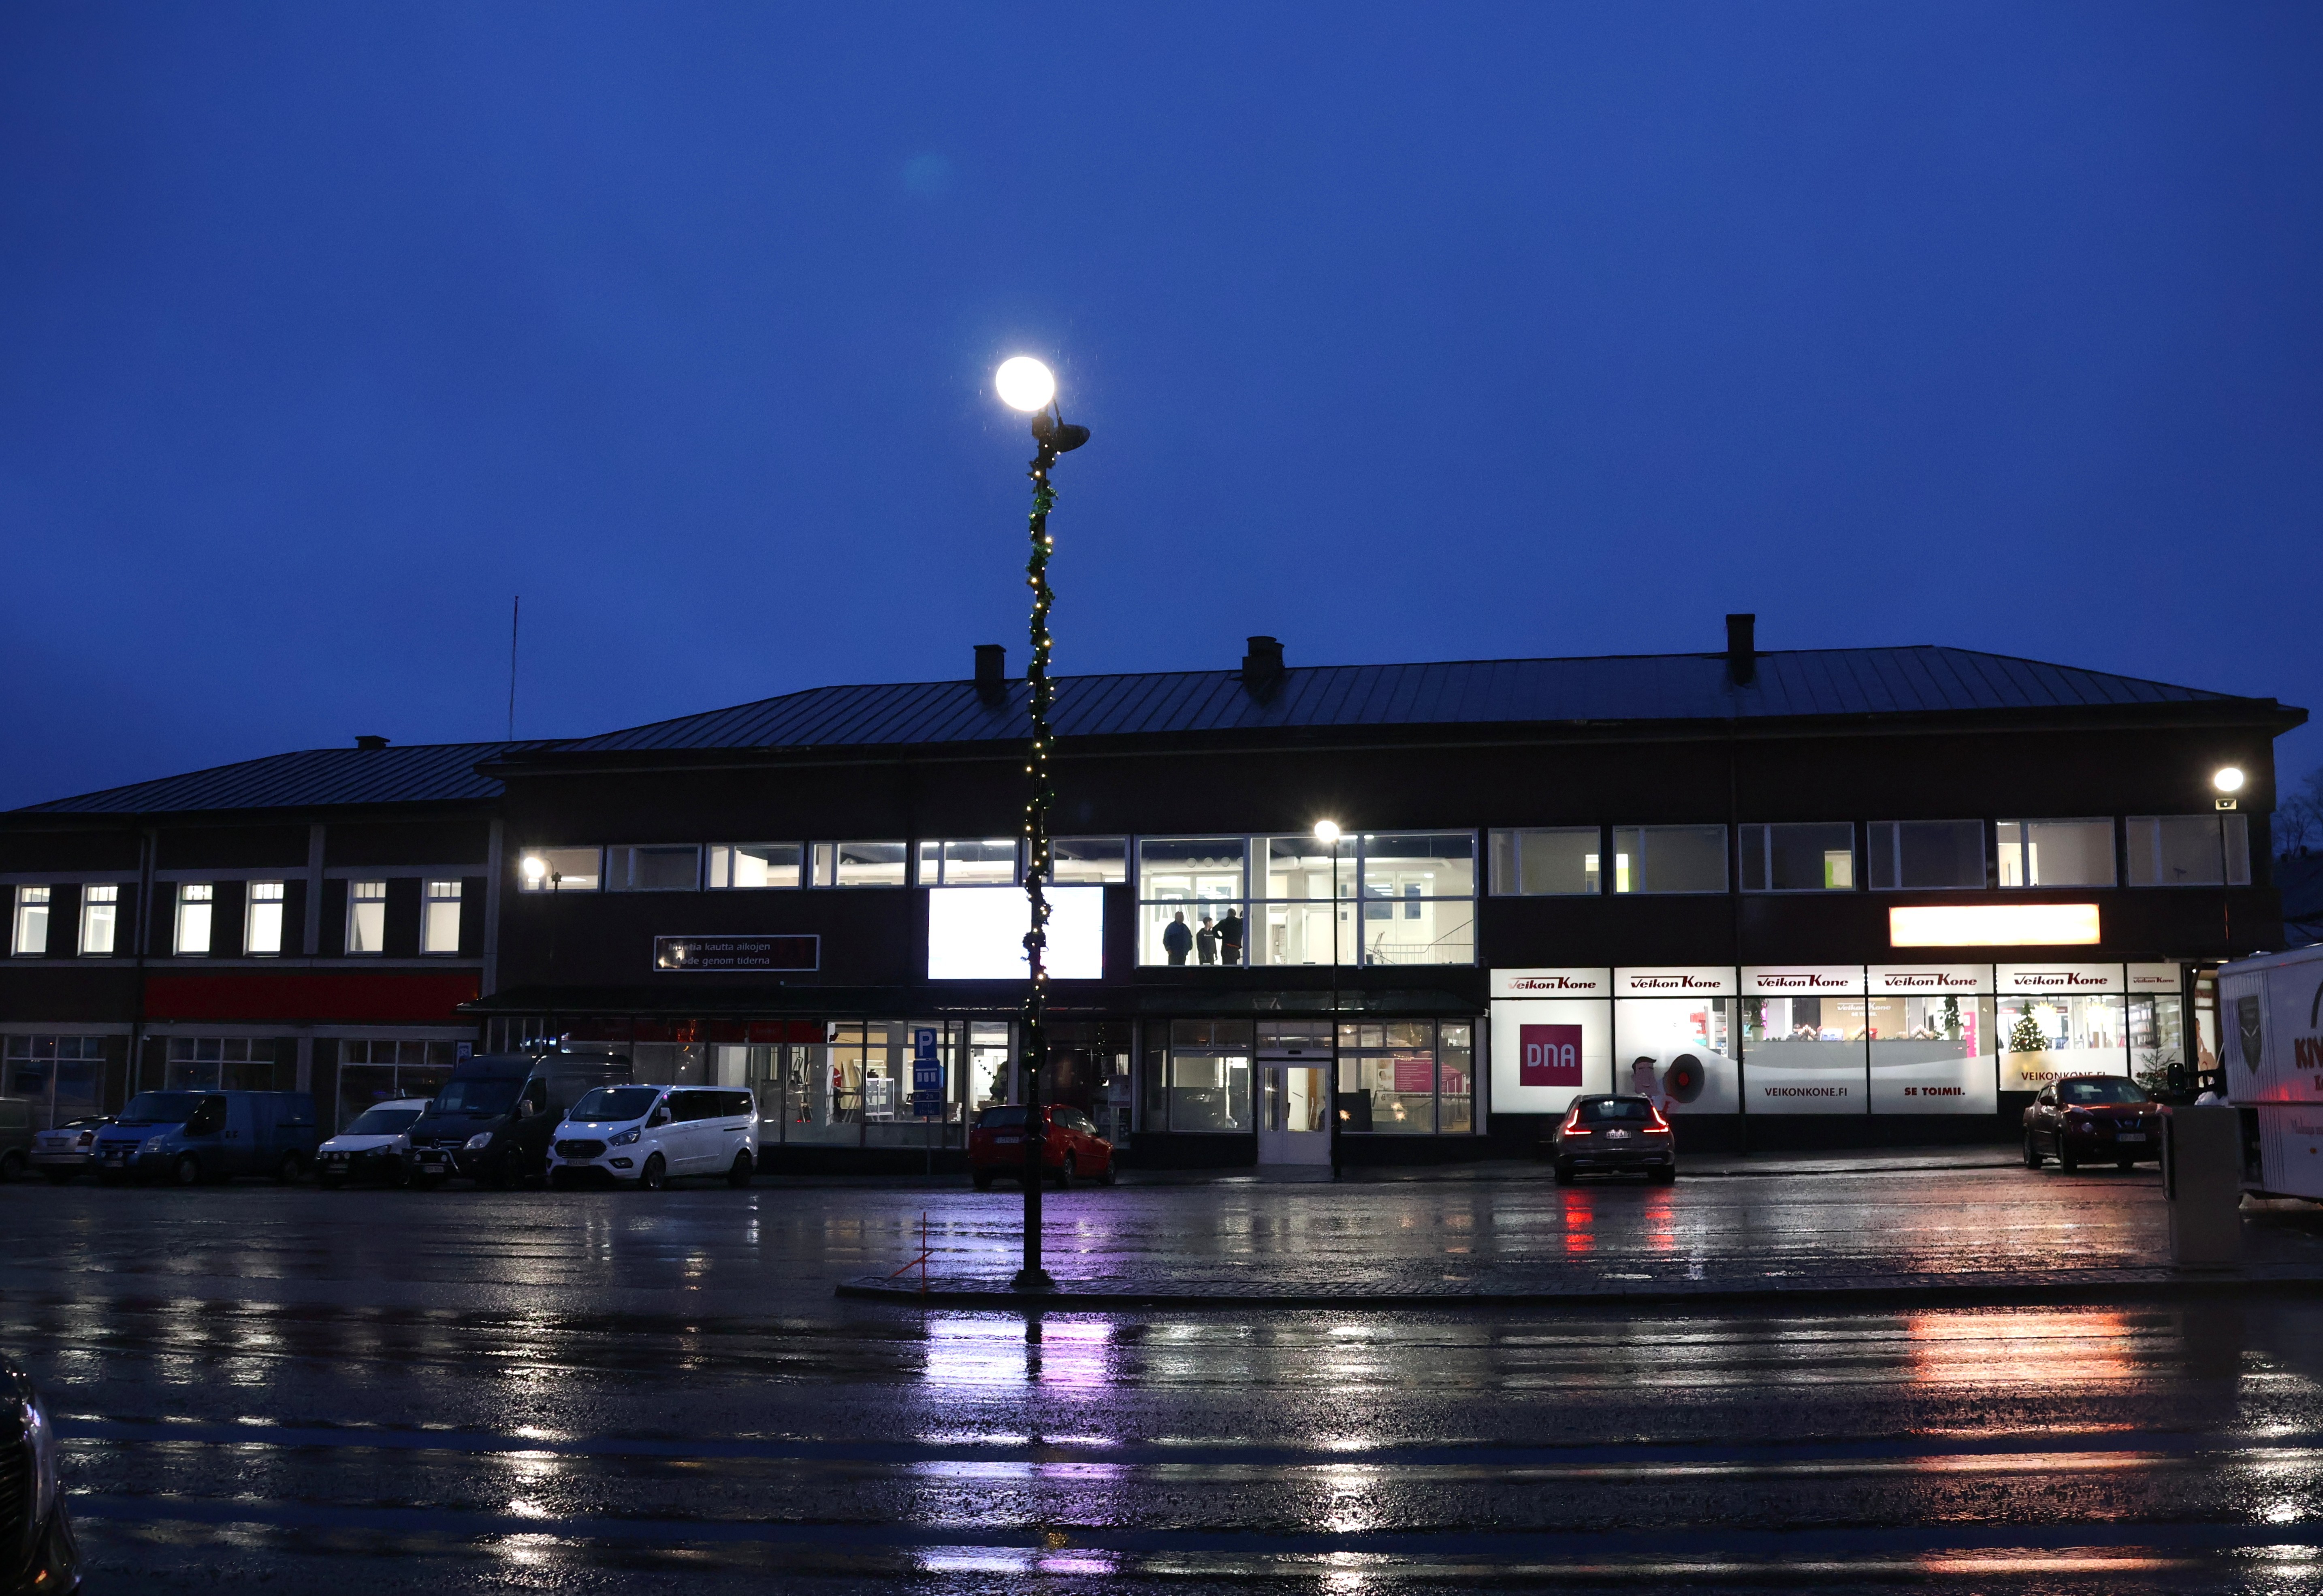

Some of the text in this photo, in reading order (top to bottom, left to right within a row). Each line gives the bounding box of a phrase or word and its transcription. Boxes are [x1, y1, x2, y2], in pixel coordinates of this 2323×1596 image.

[737, 943, 770, 952] aikojen
[702, 957, 734, 967] genom
[737, 956, 770, 964] tiderna
[1508, 977, 1596, 989] Veikon Kone
[1631, 975, 1721, 988] Veikon Kone
[1757, 974, 1848, 986] Veikon Kone
[1885, 973, 1977, 986] Veikon Kone
[2014, 973, 2108, 985] Veikon Kone
[919, 1031, 933, 1056] P
[1527, 1043, 1575, 1067] DNA
[1765, 1088, 1847, 1096] VEIKONKONE.FI
[1905, 1087, 1965, 1096] SE TOIMII.
